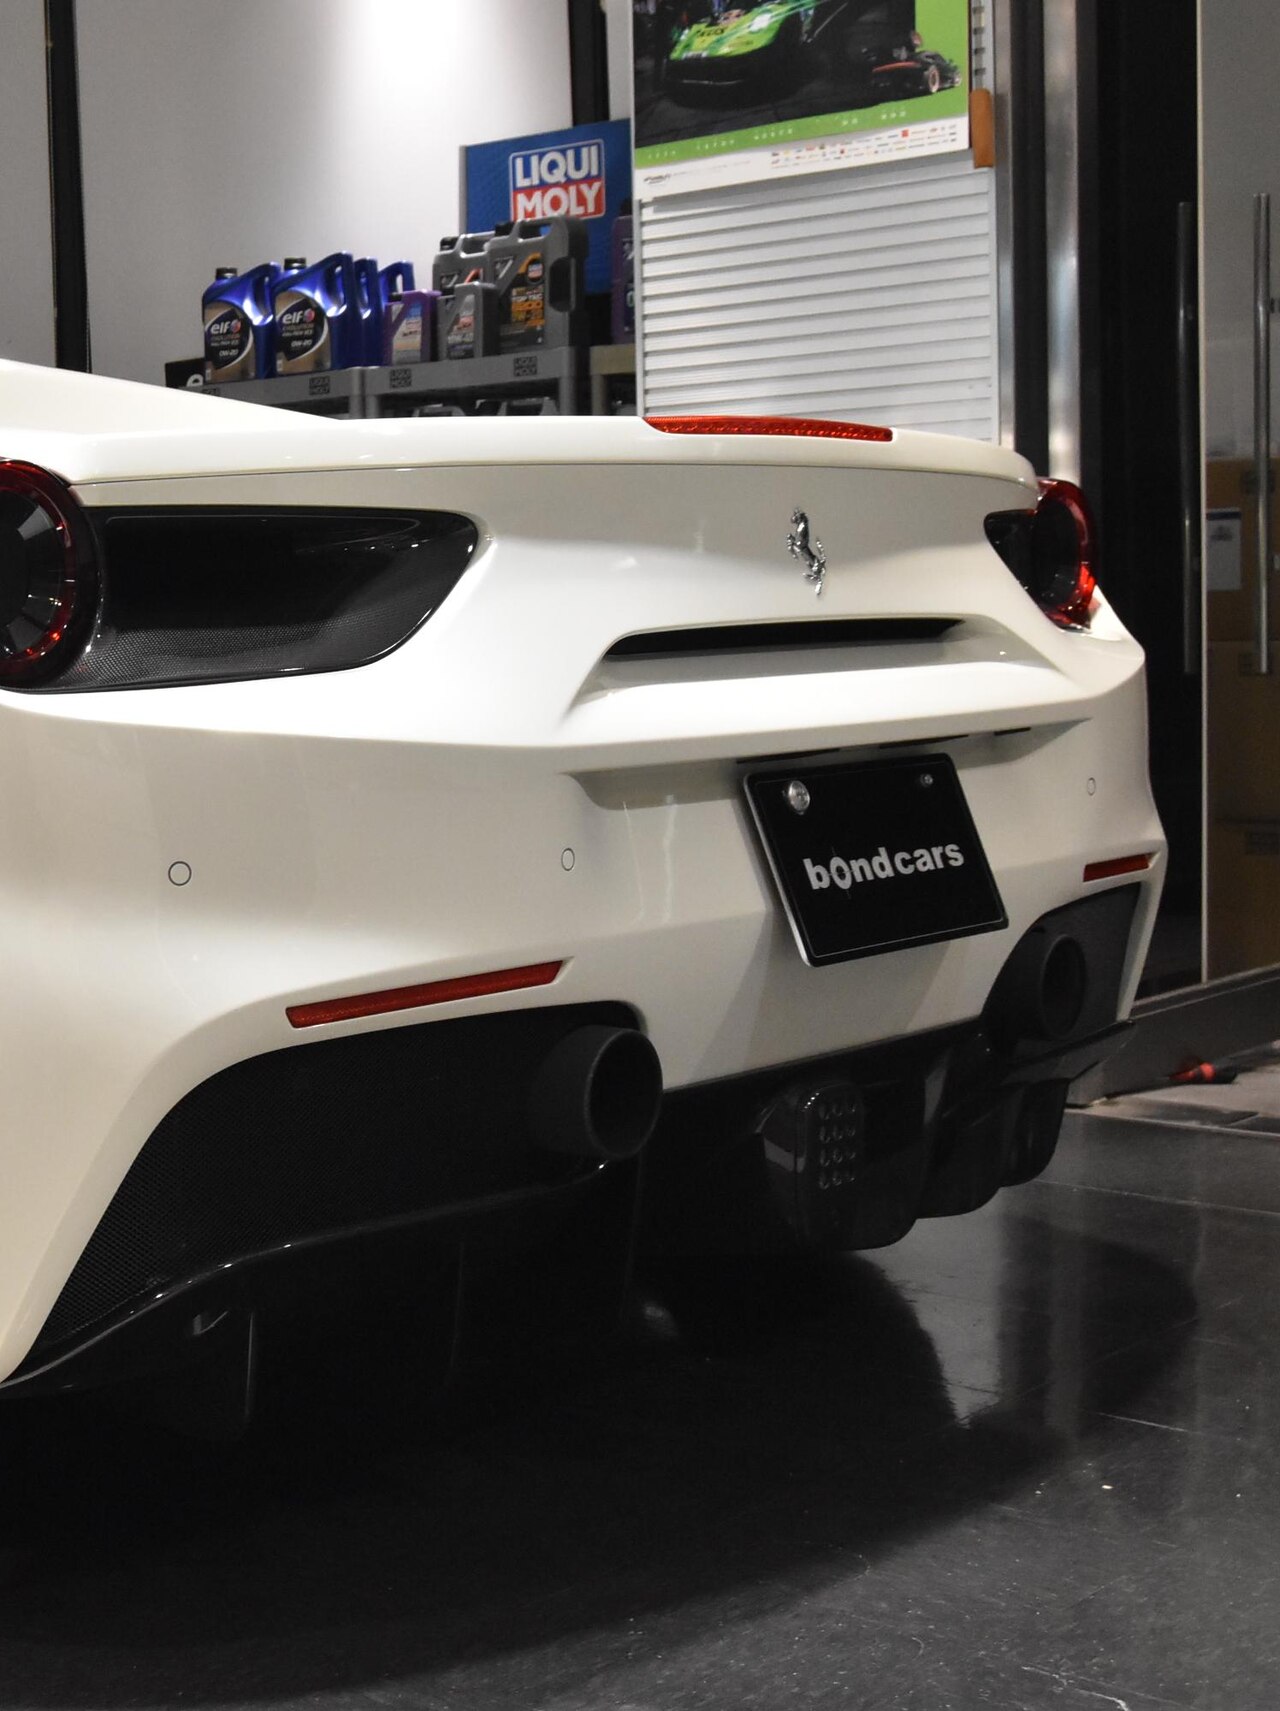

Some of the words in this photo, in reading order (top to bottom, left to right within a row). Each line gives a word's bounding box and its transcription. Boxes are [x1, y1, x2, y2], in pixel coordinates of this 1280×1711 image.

[515, 144, 599, 188] LIQUI
[516, 181, 602, 221] MOLY
[210, 320, 231, 334] elf
[282, 311, 304, 324] elf
